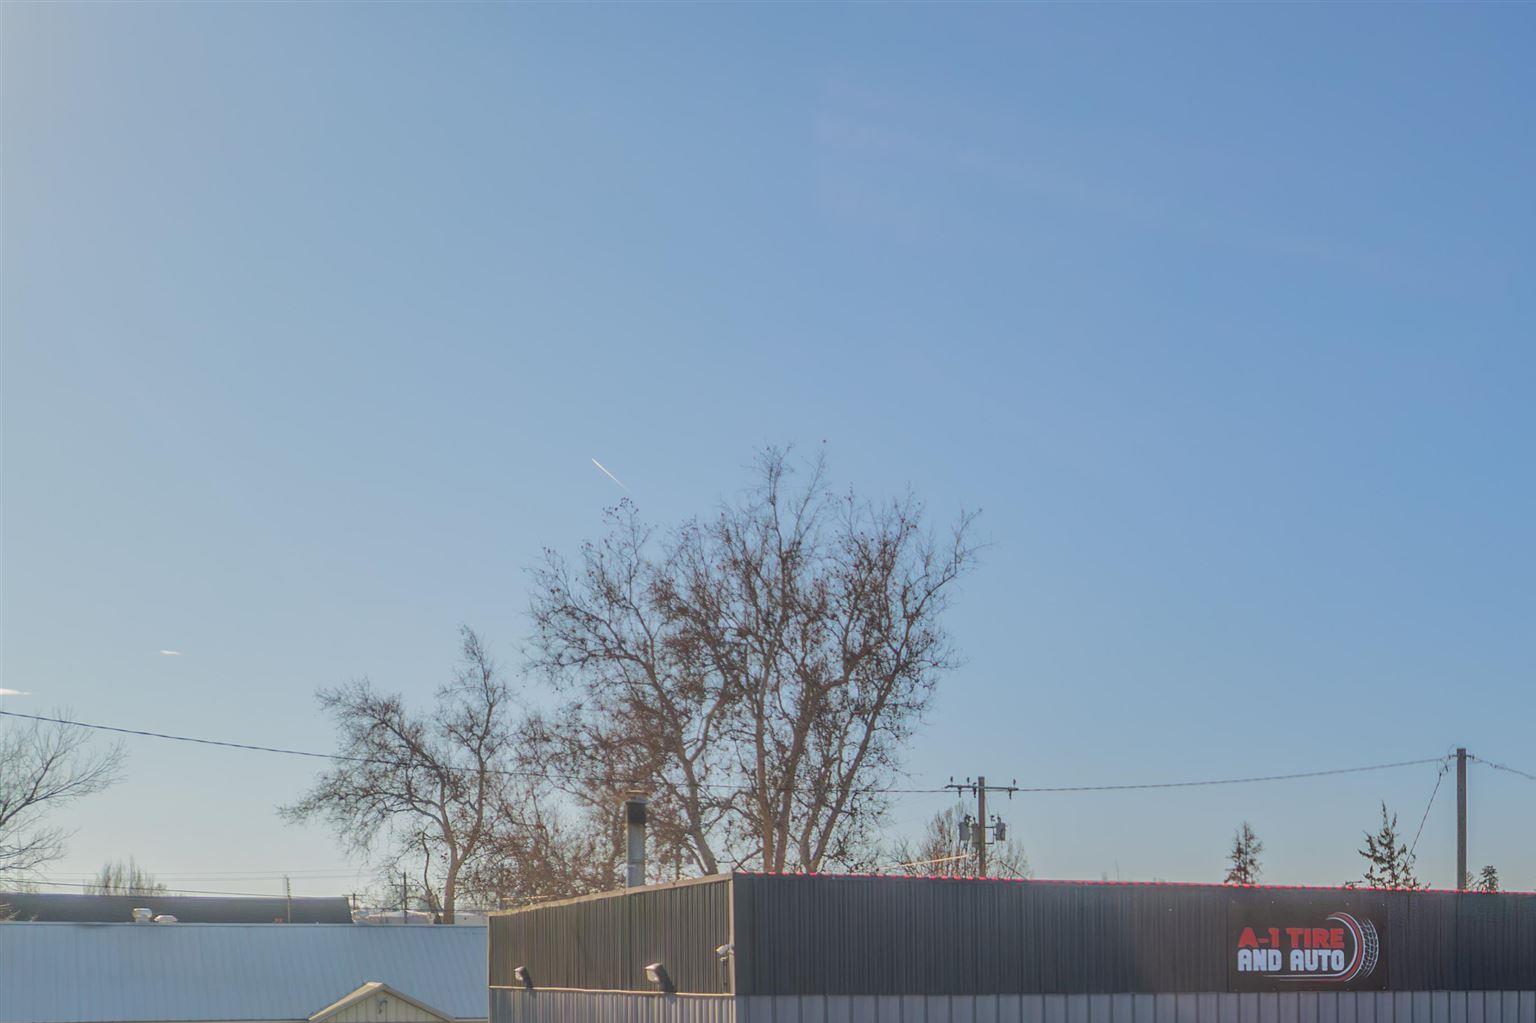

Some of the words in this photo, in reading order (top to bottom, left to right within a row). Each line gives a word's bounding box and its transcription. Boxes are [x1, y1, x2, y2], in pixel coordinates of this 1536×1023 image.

[1238, 927, 1280, 948] A-1
[1286, 927, 1345, 949] TIRE
[1237, 949, 1282, 972] AND
[1290, 949, 1345, 971] AUTO
